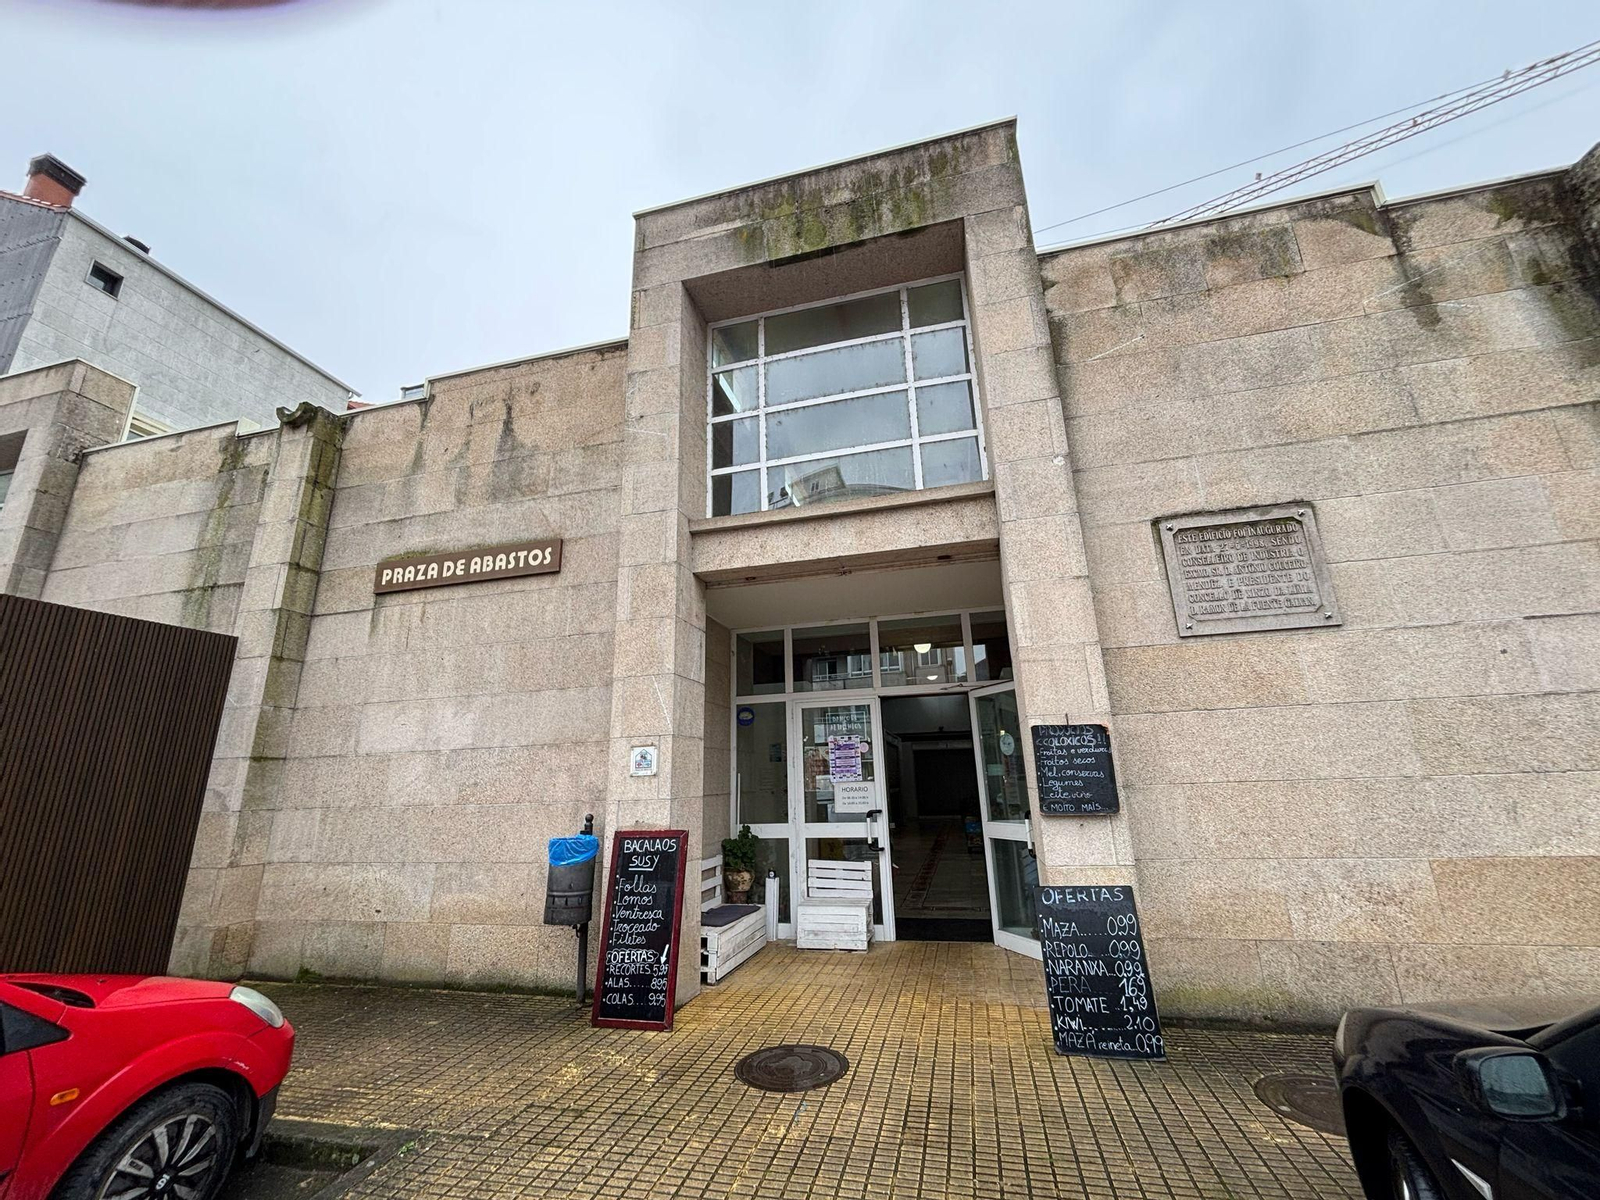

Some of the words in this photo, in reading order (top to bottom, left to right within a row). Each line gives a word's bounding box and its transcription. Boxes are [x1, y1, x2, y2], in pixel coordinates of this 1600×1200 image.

[1177, 532, 1197, 543] ESTE
[1198, 529, 1231, 541] EDIFICIO
[1232, 527, 1246, 537] FOI
[1247, 522, 1298, 536] INAUGURADO
[1179, 545, 1191, 556] EN
[381, 562, 439, 586] PRAZA
[442, 558, 466, 578] DE
[469, 547, 552, 574] ABASTOS
[1181, 553, 1235, 567] CONSELLEIRO
[1236, 551, 1248, 561] DE
[1237, 571, 1292, 586] PRESIDENTE
[1295, 569, 1309, 580] DO
[1188, 590, 1230, 605] CONCELLO
[1231, 588, 1243, 600] DE
[1227, 601, 1238, 612] DE
[1043, 777, 1083, 790] Legumes
[624, 838, 677, 853] BACALAOS
[629, 854, 660, 871] SUSY
[619, 874, 657, 893] Follas
[617, 892, 653, 906] Lomos
[1042, 887, 1124, 905] OFERTAS
[615, 905, 664, 920] Ventresca
[613, 919, 661, 933] Troceado
[612, 932, 646, 946] Filetes
[611, 950, 654, 963] OFERTAS
[1045, 940, 1088, 959] REPOLO
[609, 964, 651, 976] RECORTES
[1048, 959, 1109, 977] NARANXA
[1051, 976, 1092, 994] PERA
[1053, 996, 1110, 1014] TOMATE
